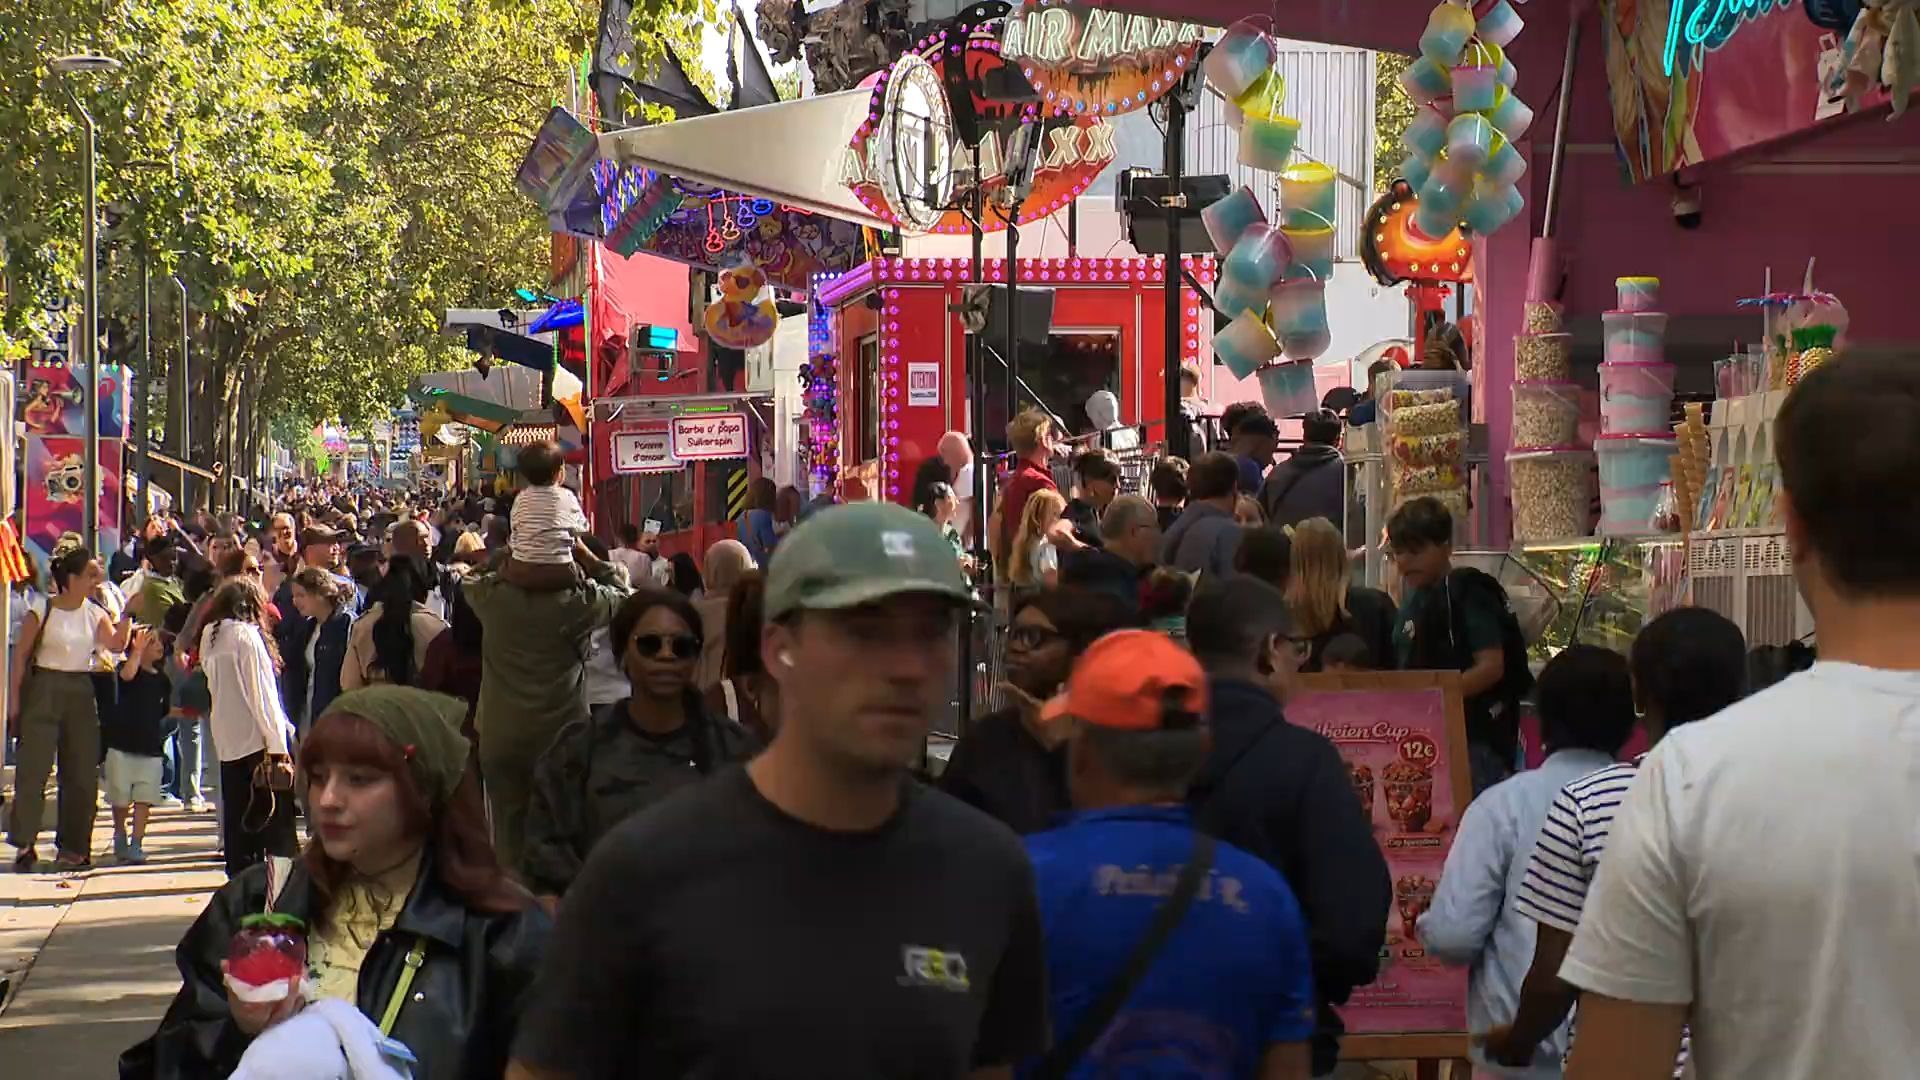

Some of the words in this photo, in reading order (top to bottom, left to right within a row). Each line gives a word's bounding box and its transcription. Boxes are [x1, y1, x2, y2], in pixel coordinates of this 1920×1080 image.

[1003, 7, 1072, 61] AIR
[678, 424, 705, 434] Barbe
[718, 424, 740, 435] papa
[634, 440, 664, 450] Pomme
[1371, 721, 1409, 741] Cup
